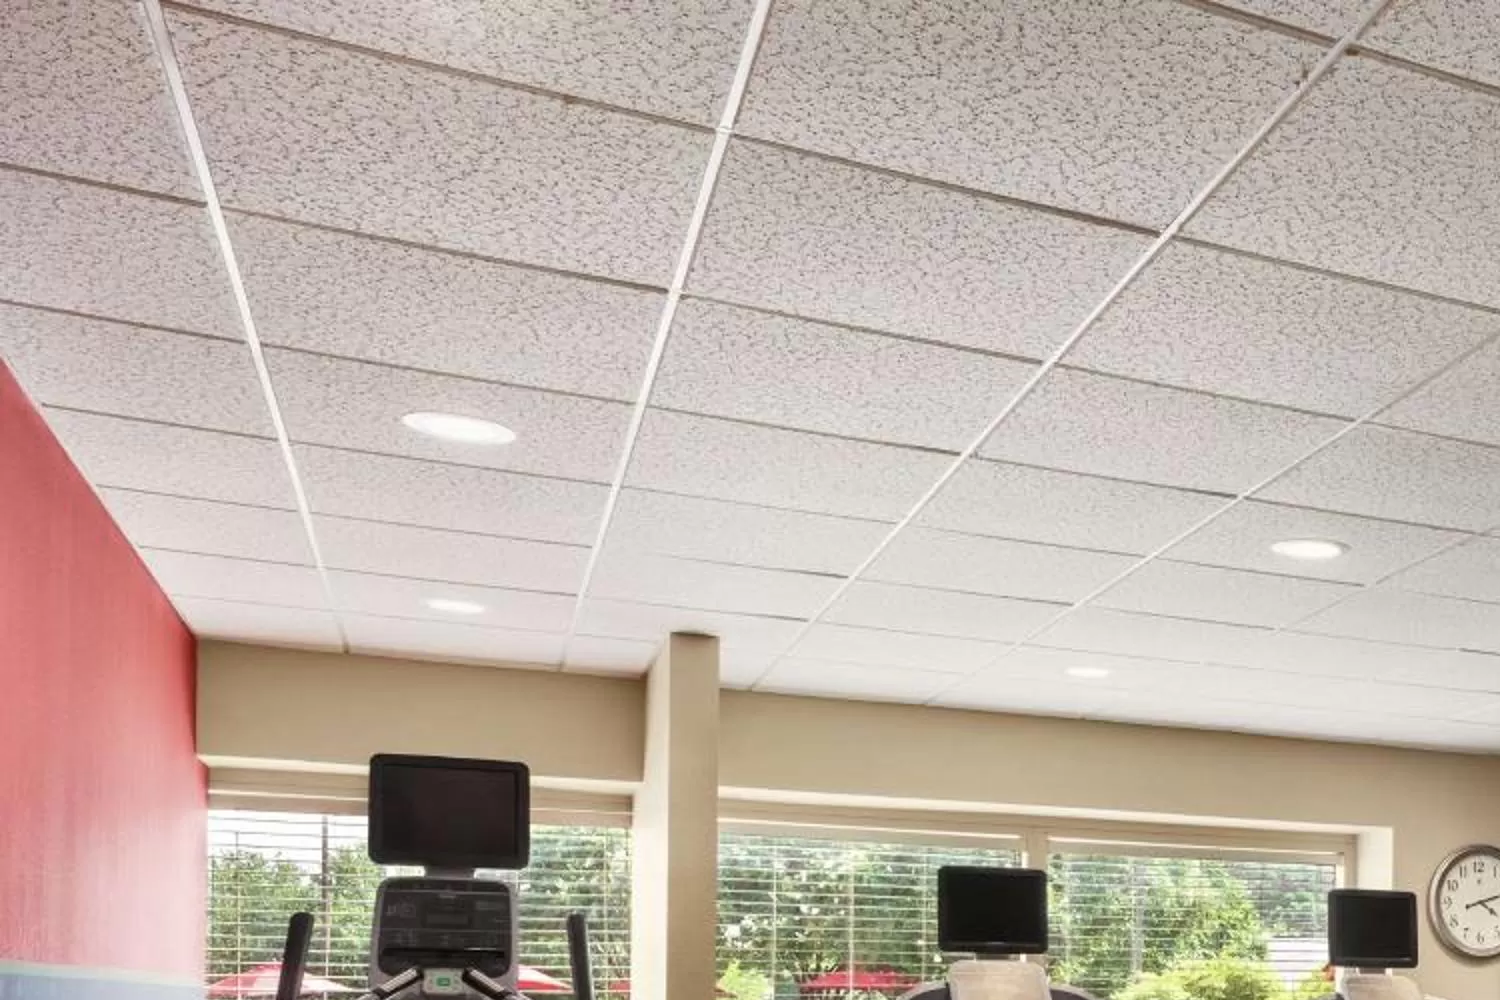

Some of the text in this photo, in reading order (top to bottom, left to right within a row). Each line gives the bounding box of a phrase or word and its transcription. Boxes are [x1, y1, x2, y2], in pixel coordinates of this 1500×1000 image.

[1459, 865, 1467, 878] 11
[1473, 861, 1484, 873] 12
[1446, 879, 1459, 892] 10
[1443, 896, 1453, 909] 9
[1449, 914, 1459, 928] 8
[1475, 932, 1485, 944] 6
